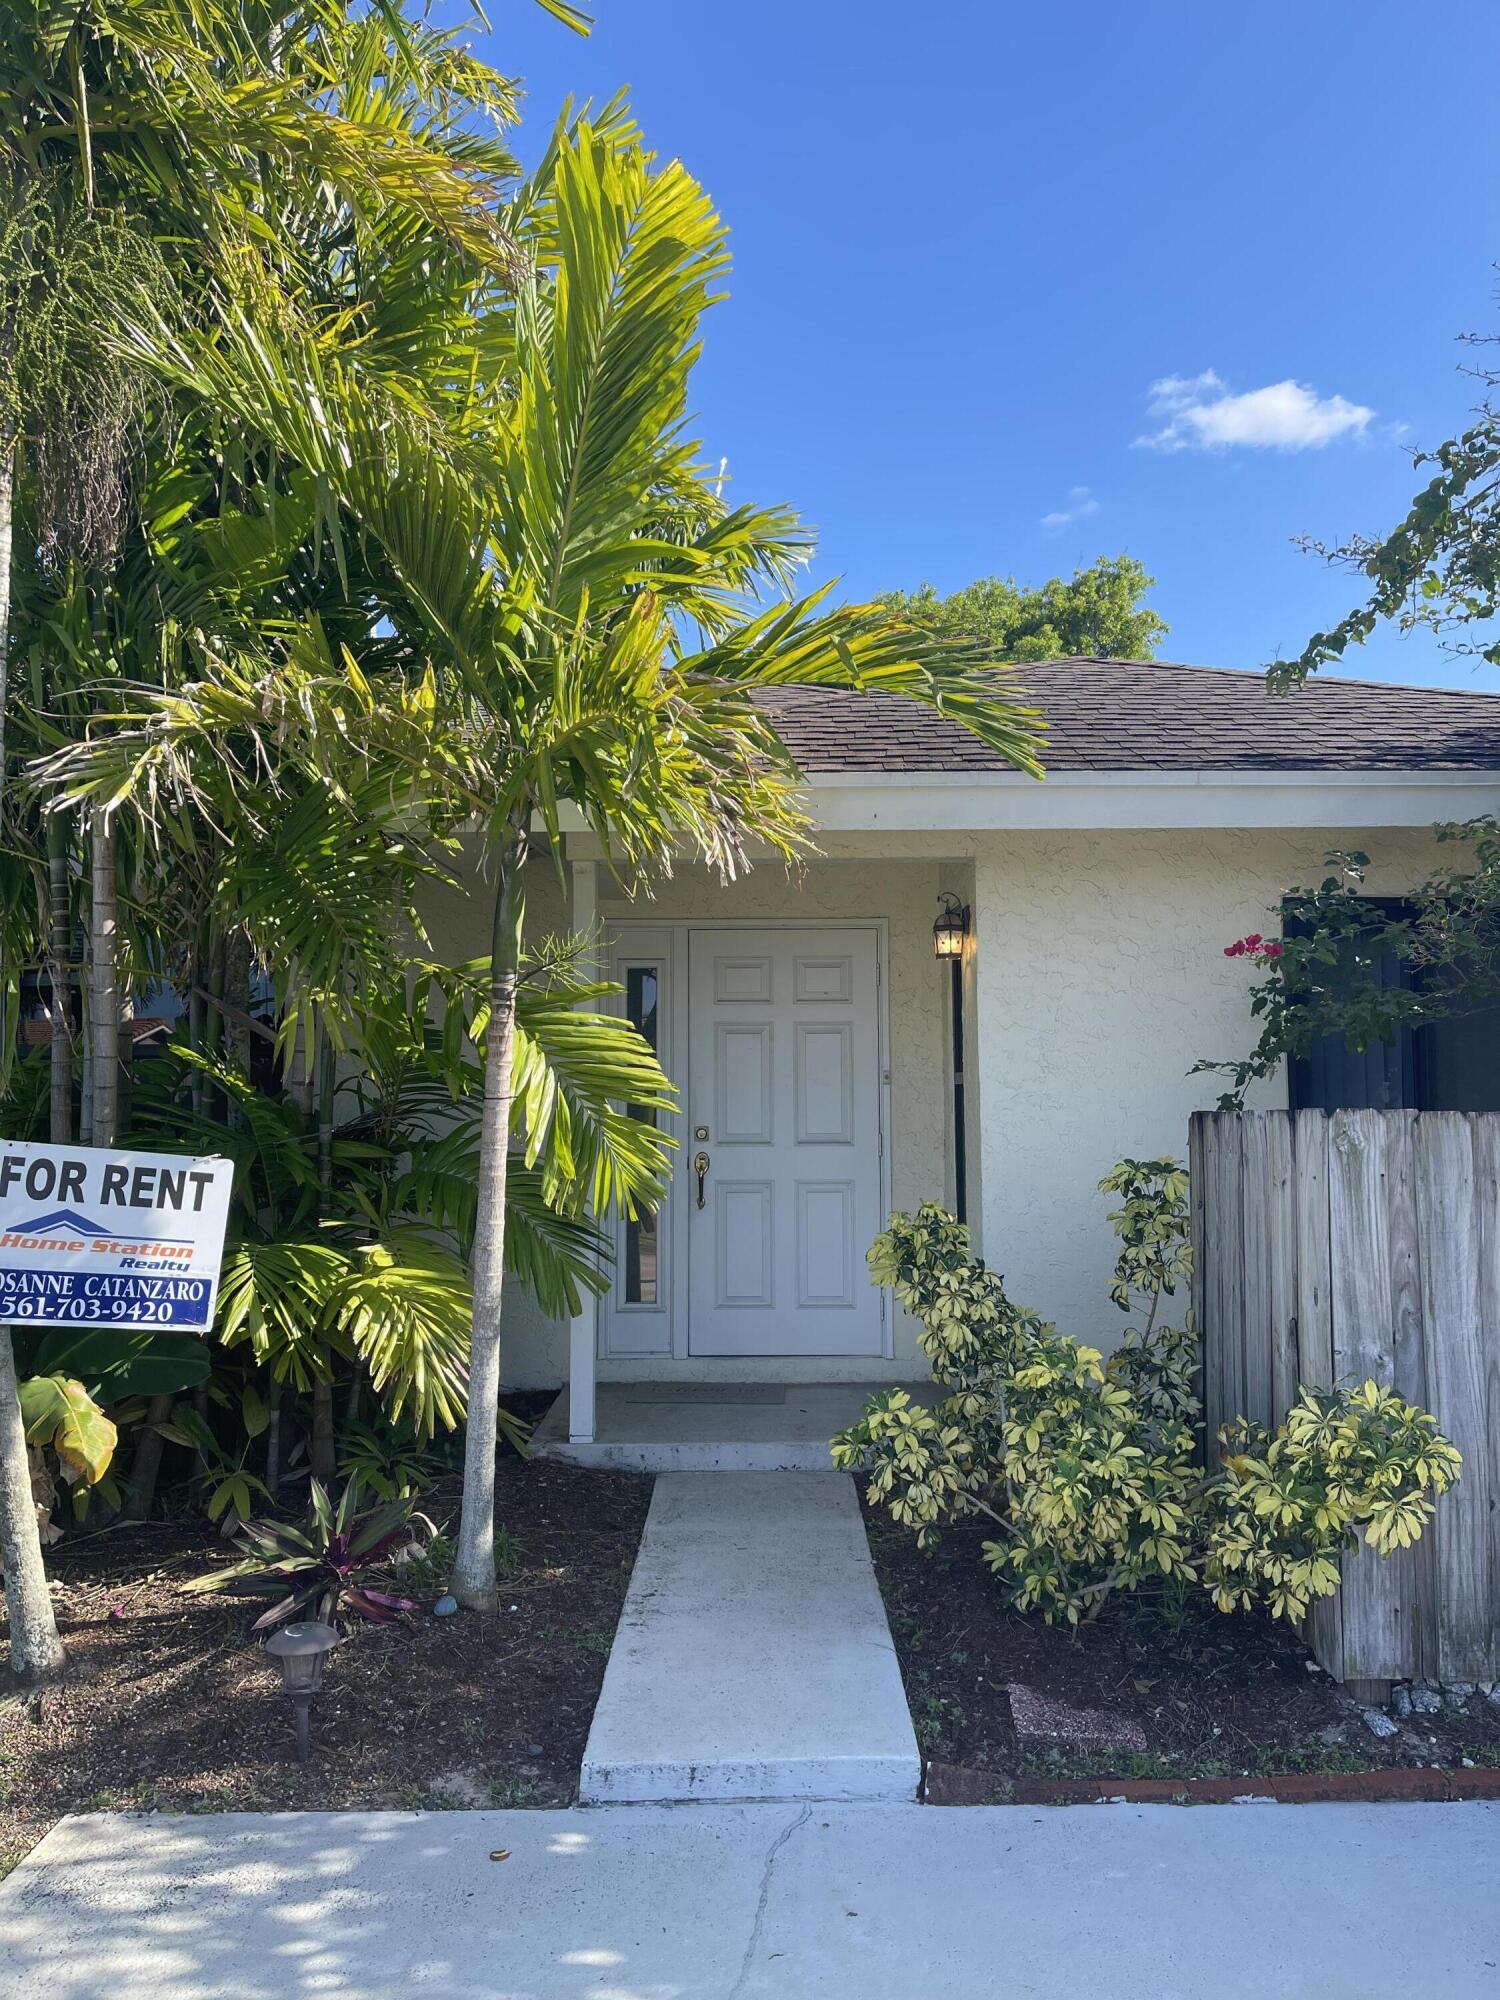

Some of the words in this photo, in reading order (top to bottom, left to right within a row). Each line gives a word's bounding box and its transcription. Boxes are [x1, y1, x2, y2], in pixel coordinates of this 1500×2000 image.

[0, 1155, 87, 1203] FOR
[100, 1164, 214, 1212] RENT
[0, 1233, 85, 1252] Home
[90, 1239, 194, 1259] Station
[119, 1257, 190, 1272] Realty
[84, 1276, 204, 1301] CATANZARO
[0, 1295, 173, 1321] 561-703-9420
